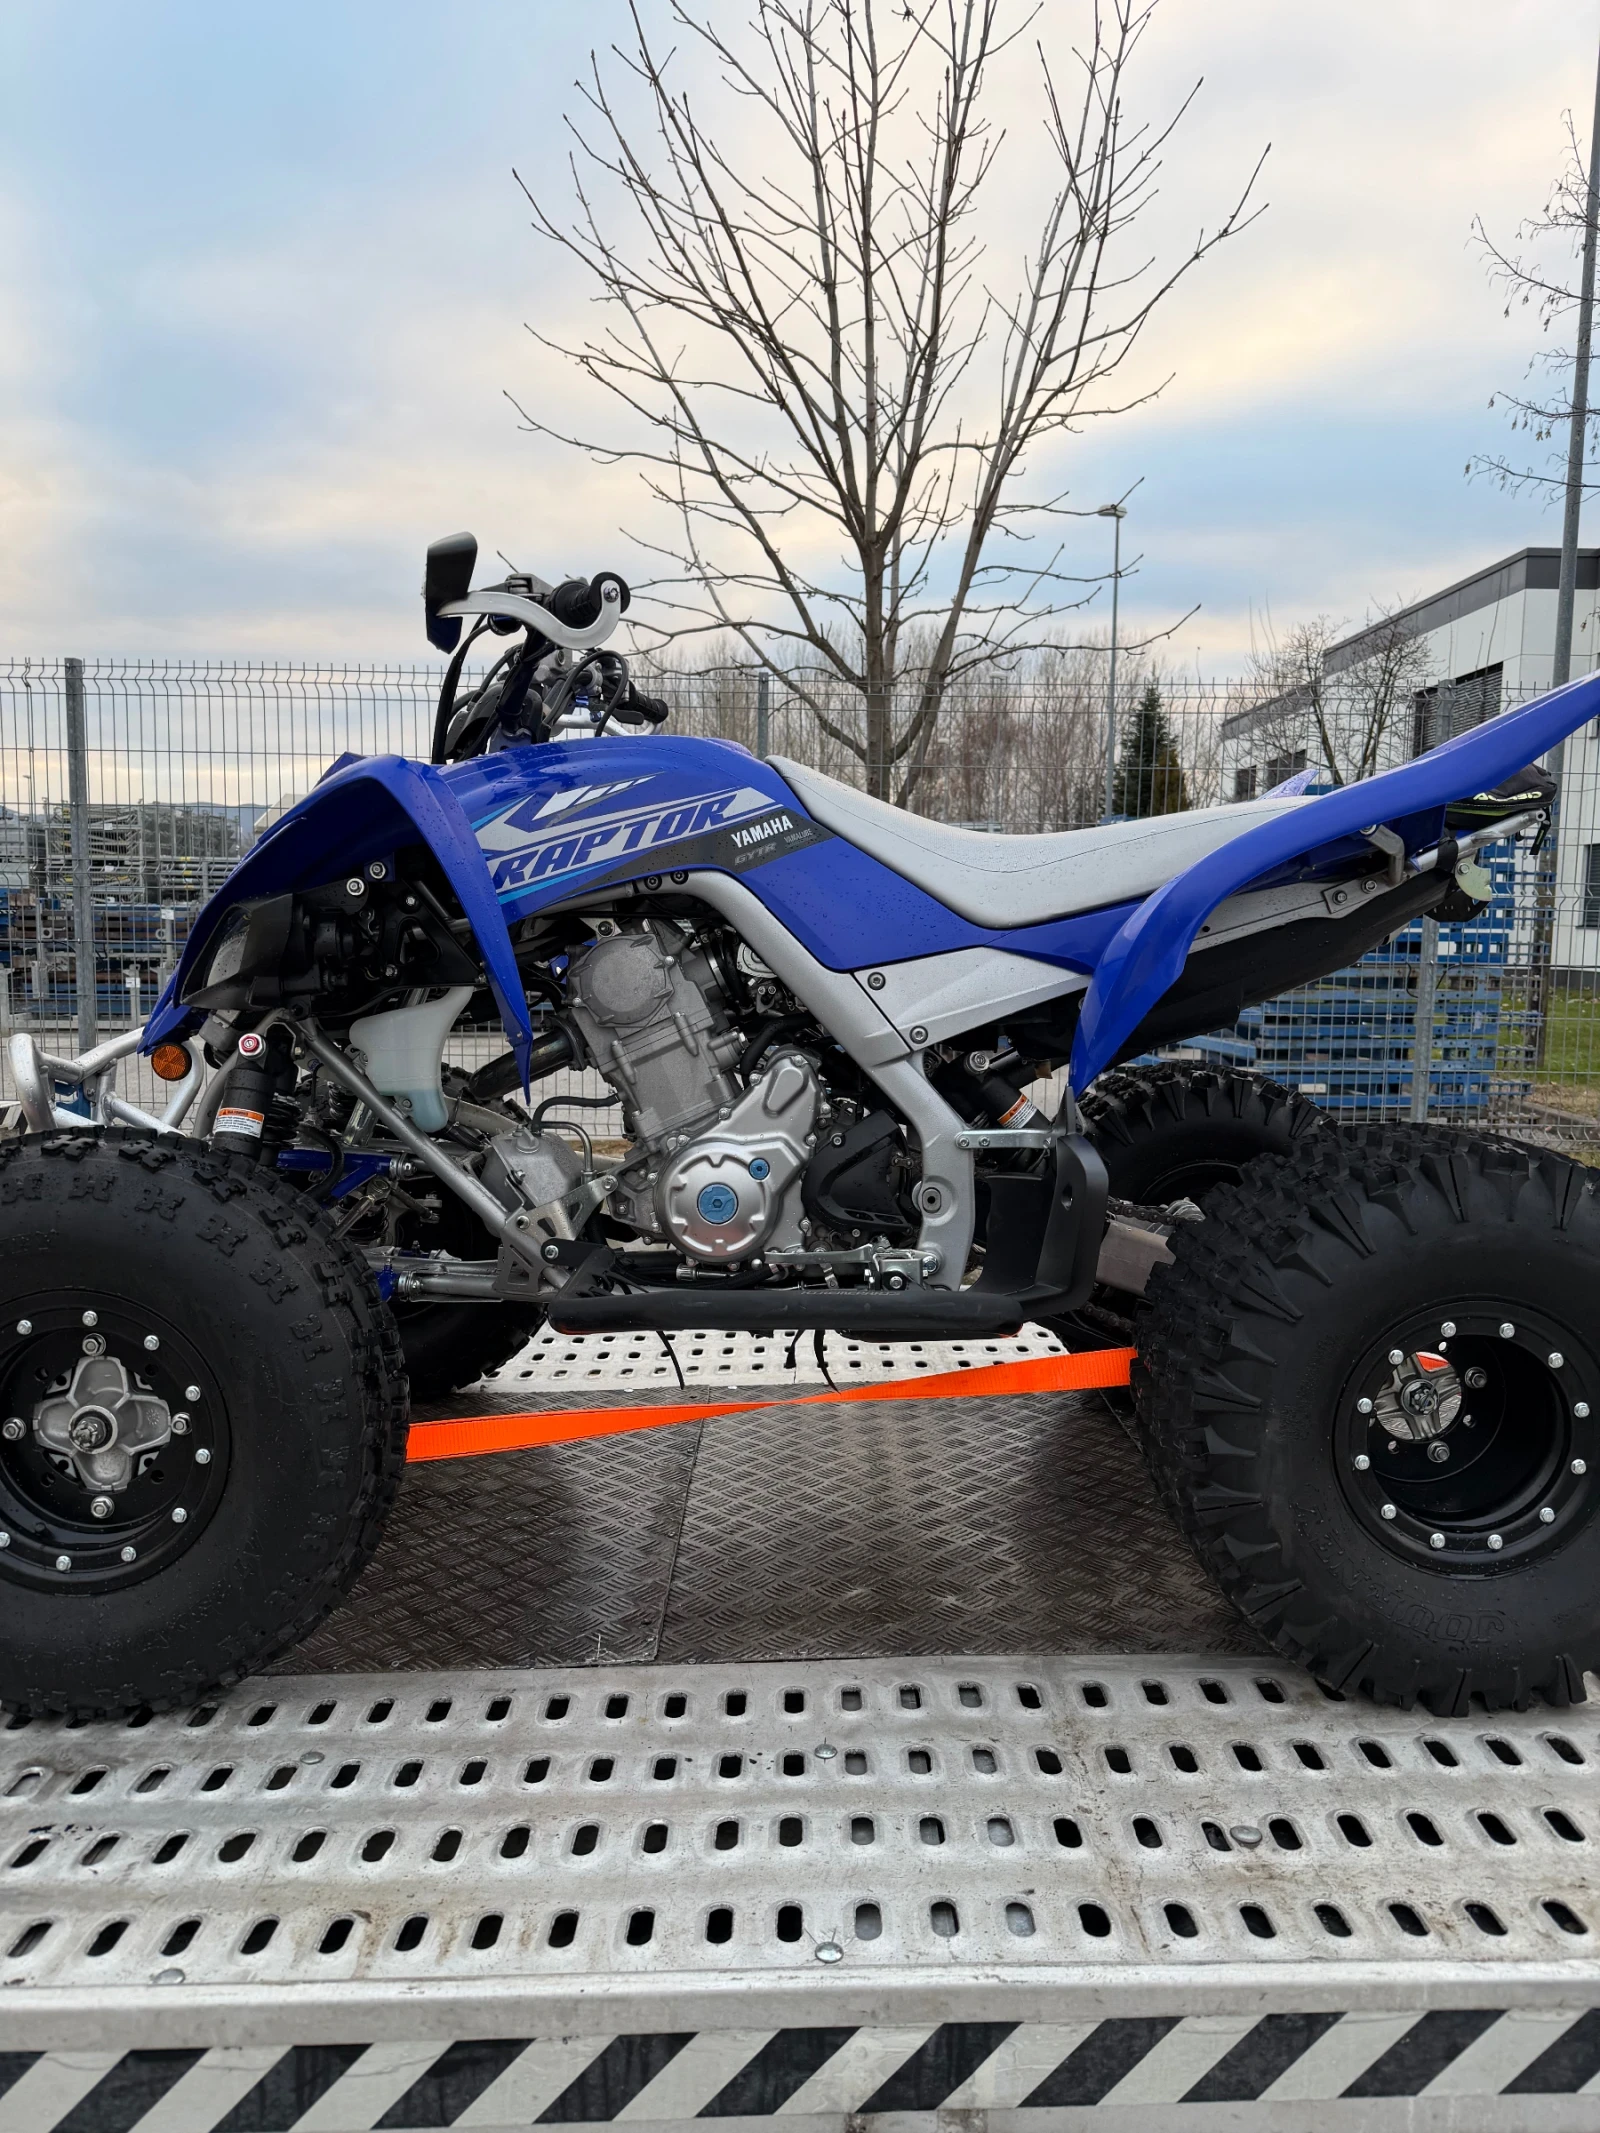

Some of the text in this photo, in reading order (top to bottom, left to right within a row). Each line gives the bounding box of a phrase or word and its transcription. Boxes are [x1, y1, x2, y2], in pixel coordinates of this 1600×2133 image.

[492, 792, 740, 889] RAPTOR
[731, 814, 793, 848] YAMAHA
[783, 828, 813, 844] YAMALUBE
[734, 842, 777, 866] GYTR
